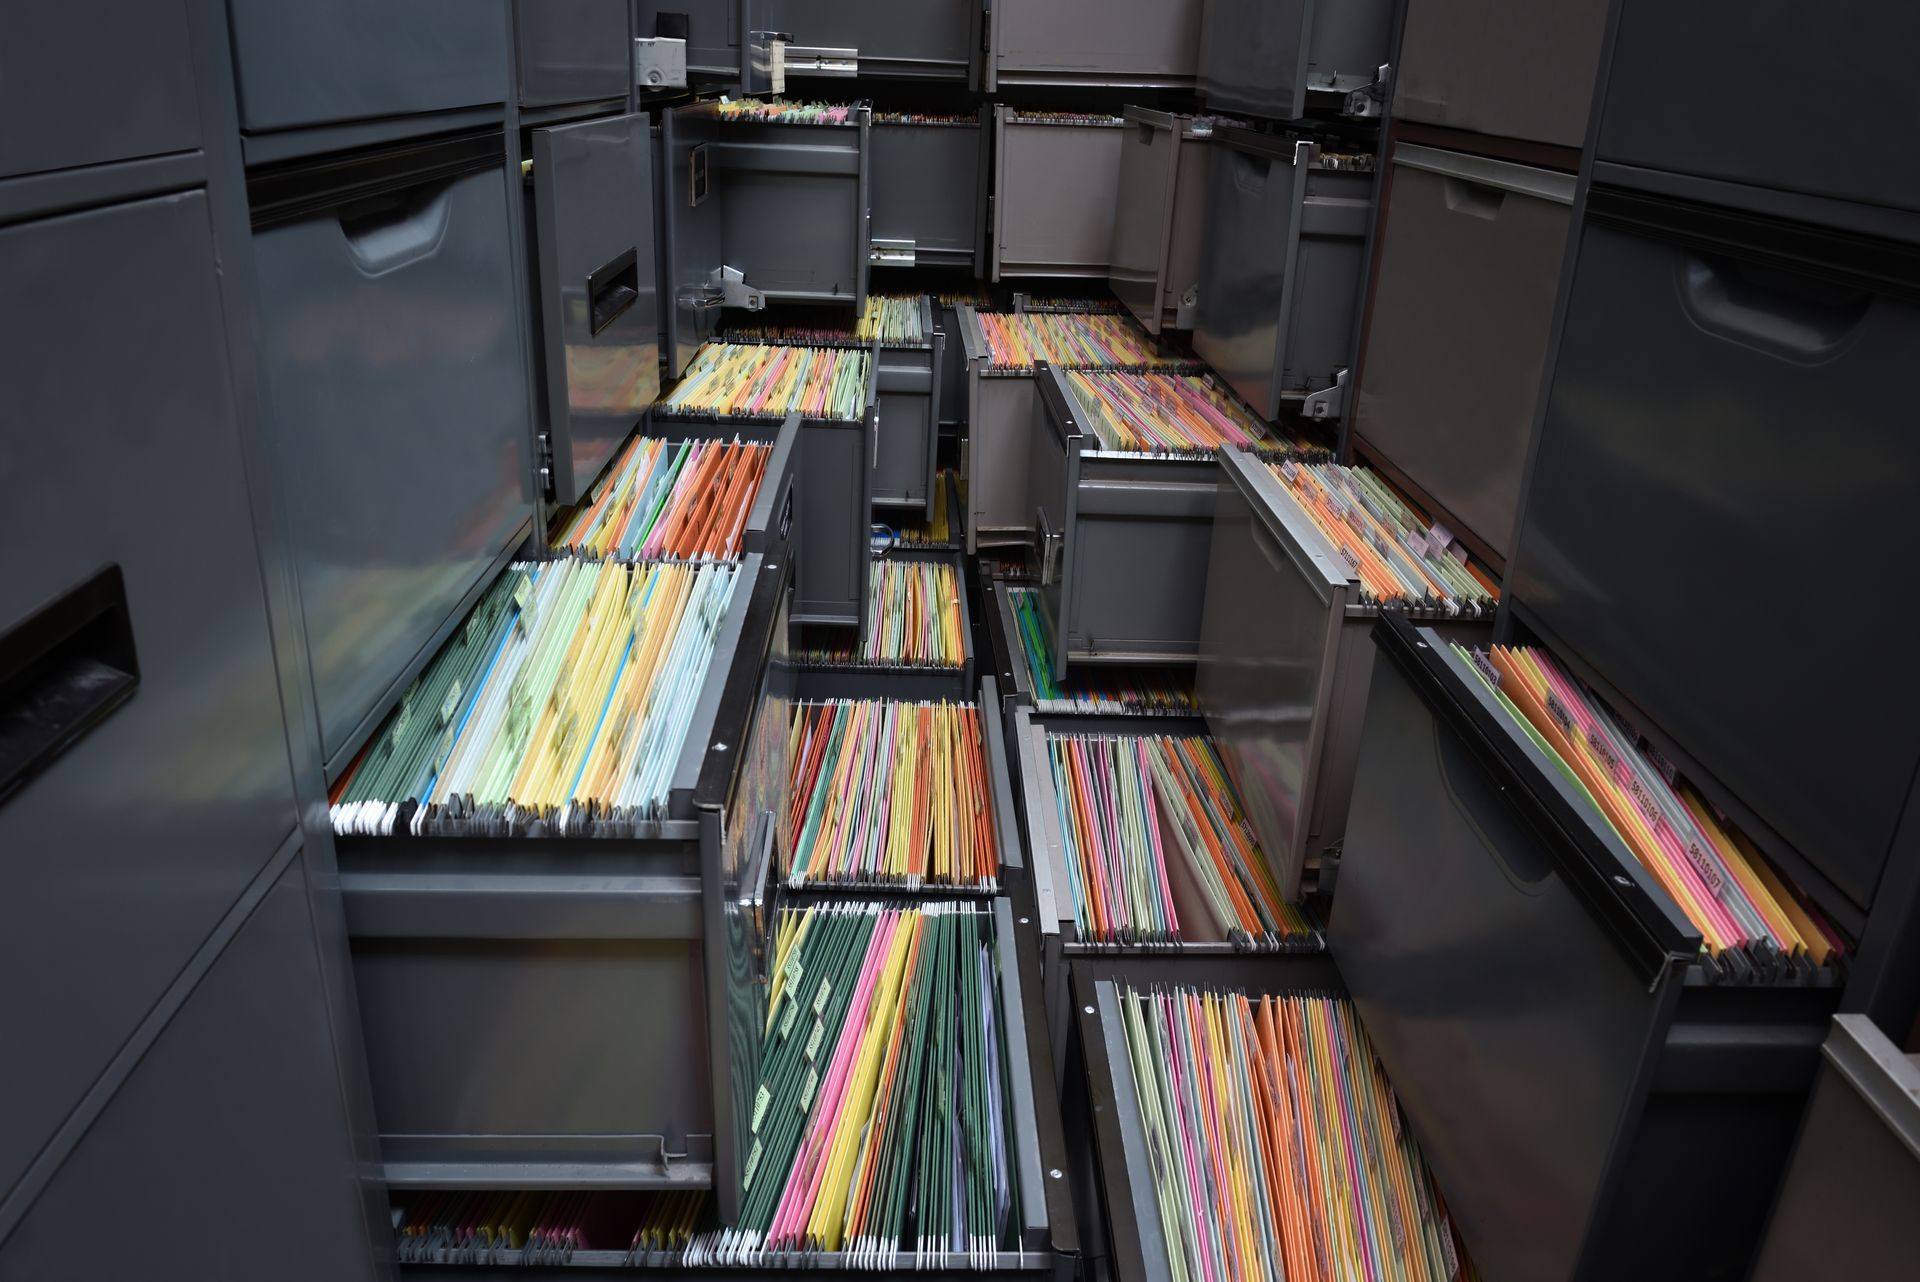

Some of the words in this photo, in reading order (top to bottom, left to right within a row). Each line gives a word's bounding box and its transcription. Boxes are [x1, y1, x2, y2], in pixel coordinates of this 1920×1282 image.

[1340, 548, 1358, 569] 57111167
[1473, 654, 1497, 685] 58110103
[1590, 734, 1615, 770] 58110105
[1631, 781, 1659, 822] 58110106
[1688, 843, 1721, 889] 58110107
